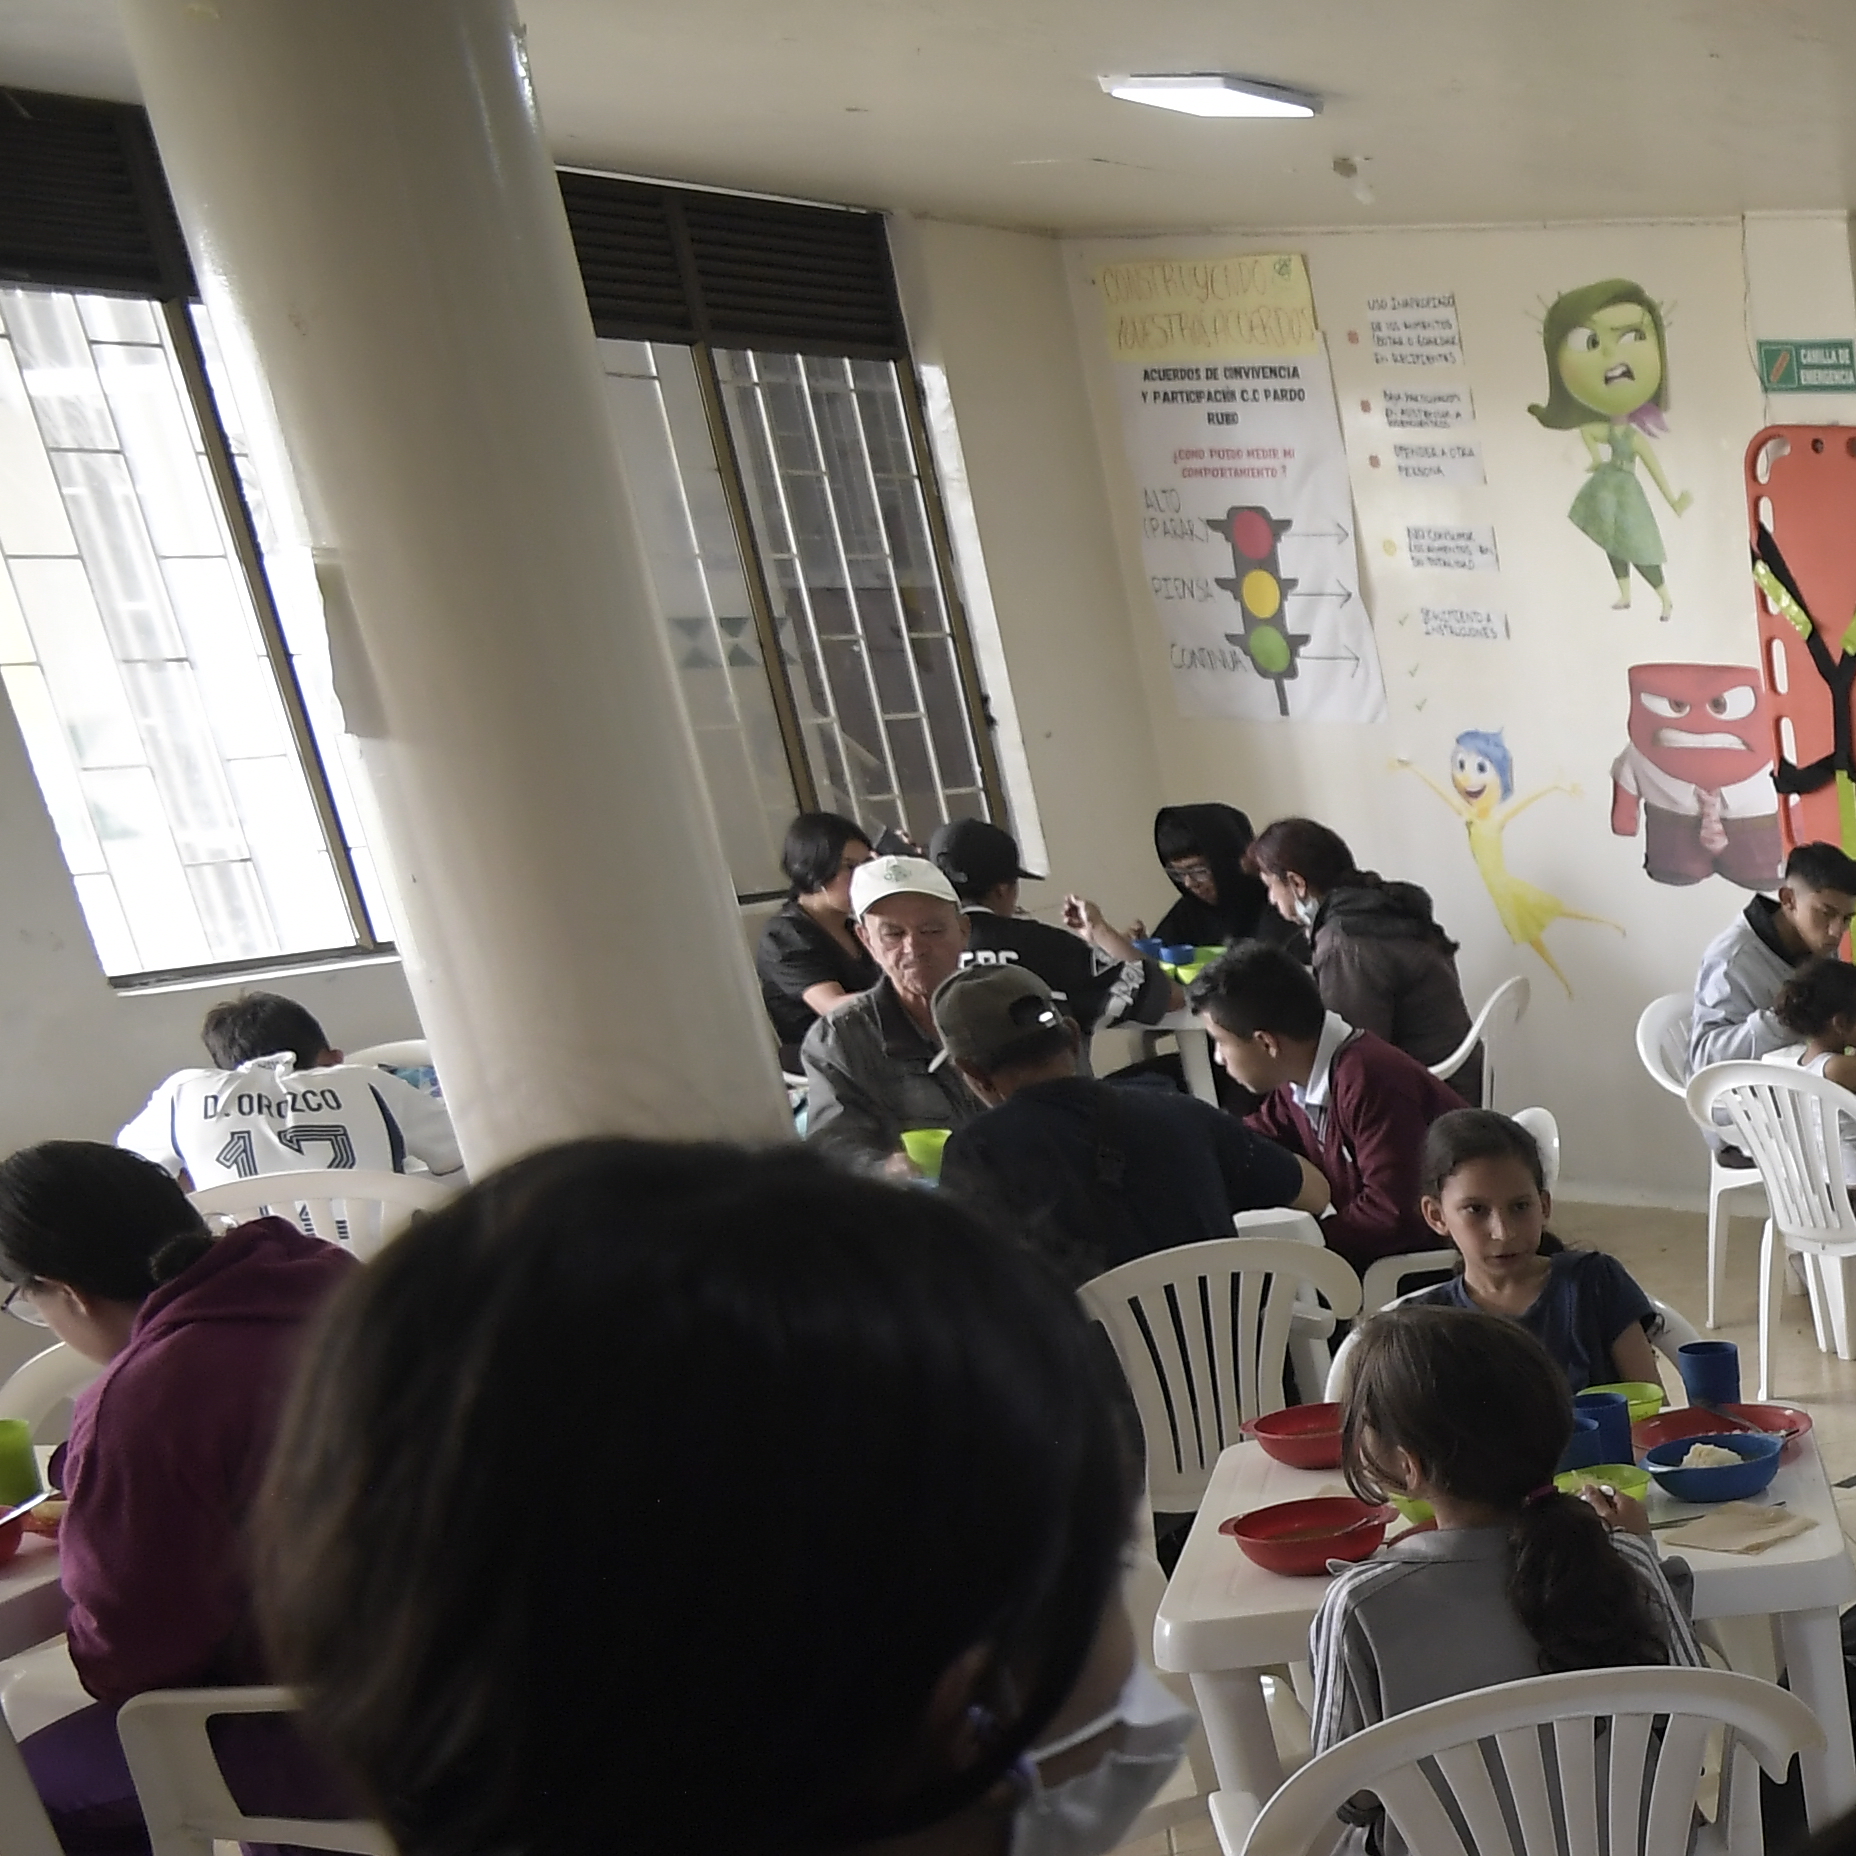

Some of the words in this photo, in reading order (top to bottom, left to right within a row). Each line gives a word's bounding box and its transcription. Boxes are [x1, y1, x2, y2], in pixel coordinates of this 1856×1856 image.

[1801, 349, 1837, 364] CAMILLA
[1838, 348, 1851, 364] DE
[1143, 368, 1200, 382] ACUERDOS
[1206, 367, 1219, 381] DE
[1224, 366, 1300, 380] CONVIVENCIA
[1801, 369, 1855, 385] EMERGENCIA
[1141, 390, 1148, 403] Y
[1264, 388, 1305, 402] PARDO
[1210, 449, 1243, 460] PUEDO
[1247, 448, 1279, 460] MEDIR
[1182, 467, 1277, 478] COMPORTAMIENTO
[1144, 488, 1181, 513] ALTO
[1152, 577, 1214, 601] PIENSA
[1170, 643, 1248, 672] CONTINUA
[203, 1094, 231, 1120] D.
[237, 1088, 342, 1119] OROZCO
